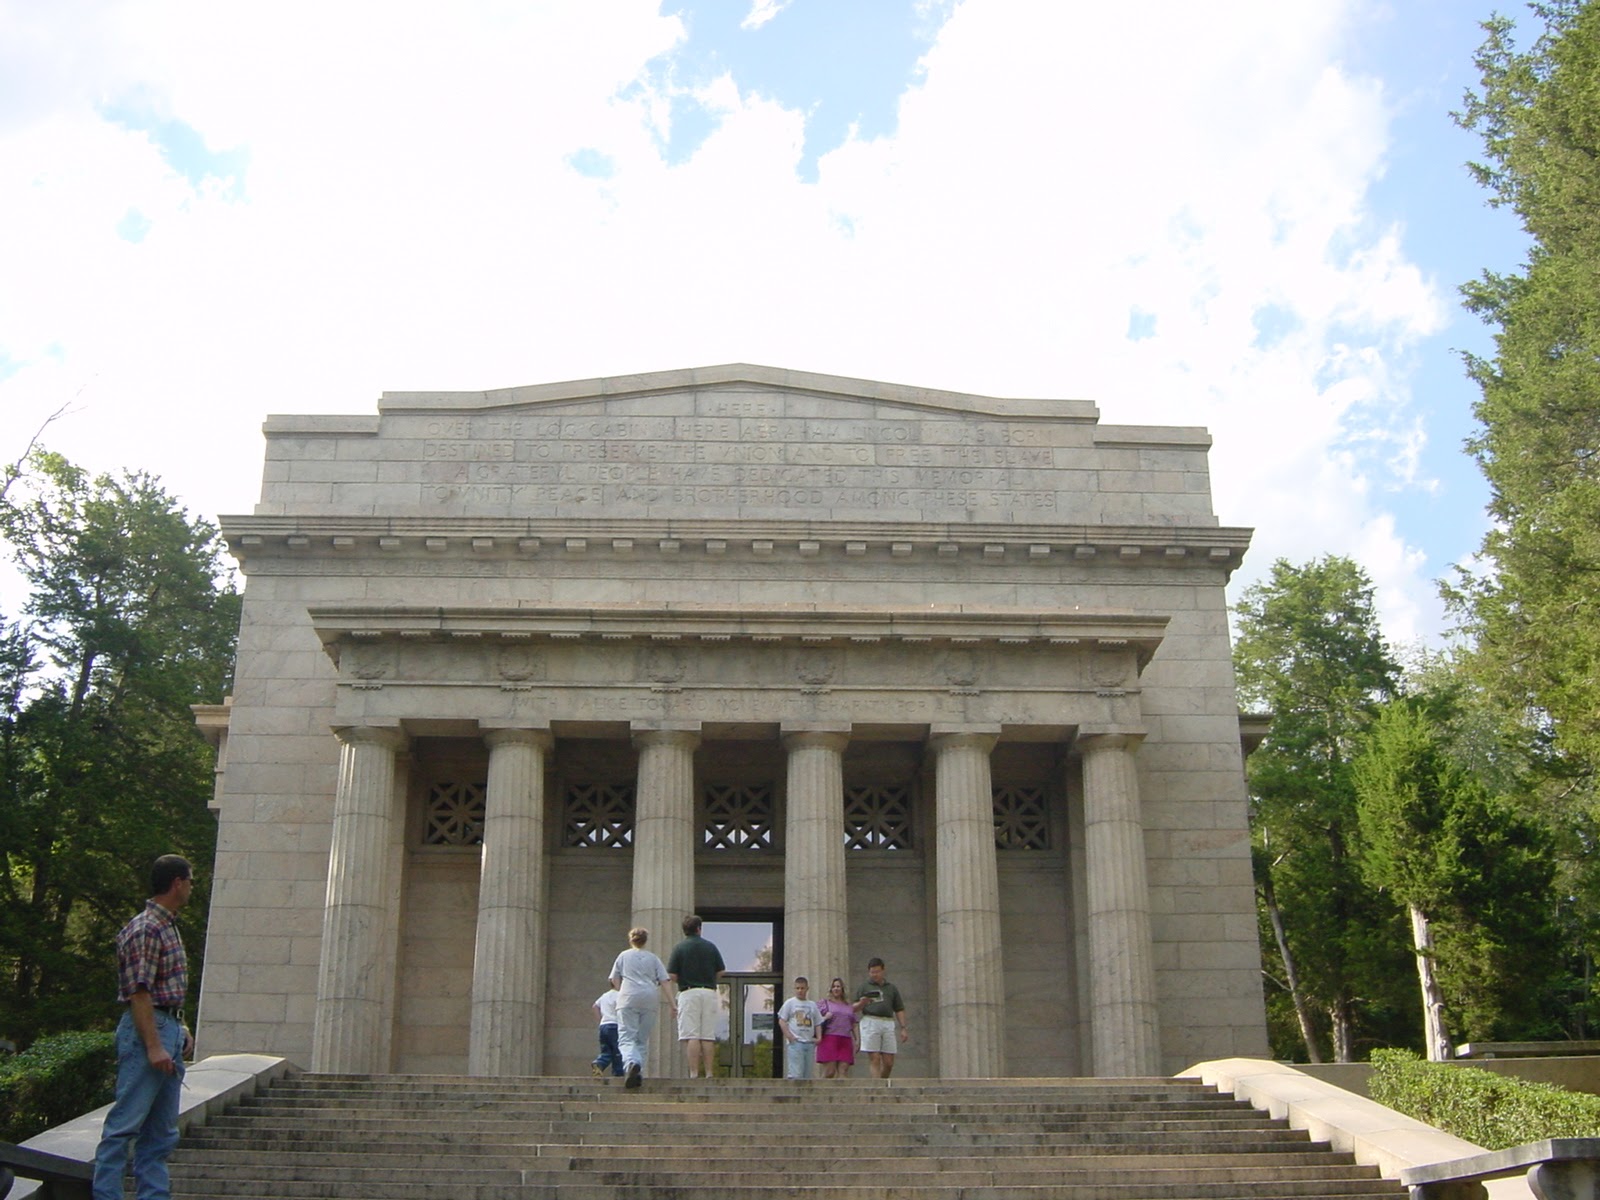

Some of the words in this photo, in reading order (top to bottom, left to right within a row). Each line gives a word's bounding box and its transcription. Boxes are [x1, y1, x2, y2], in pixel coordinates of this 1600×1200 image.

[716, 403, 767, 417] HERE
[428, 422, 474, 437] OVER
[488, 422, 523, 437] THE
[537, 422, 576, 437] LOG
[589, 423, 648, 438] CABIN
[741, 425, 839, 440] ABRAHAM
[1001, 429, 1052, 443] BORN
[424, 443, 514, 458] DESTINED
[525, 443, 550, 458] TO
[563, 444, 657, 459] PRESERVE
[669, 445, 705, 460] THE
[718, 446, 783, 461] VNION
[792, 447, 834, 462] AND
[844, 447, 869, 462] TO
[886, 448, 931, 463] FREE
[943, 449, 981, 464] THE
[994, 450, 1051, 465] SLAVE
[454, 465, 467, 479] A
[477, 465, 576, 480] GRATEFVL
[588, 466, 658, 481] PEOPLE
[670, 467, 720, 482] HAVE
[735, 467, 847, 483] DEDICATED
[858, 469, 899, 484] THIS
[915, 470, 1024, 486] MEMORIAL
[423, 485, 449, 500] TO
[537, 487, 602, 502] PEACE
[616, 488, 659, 503] AND
[672, 488, 824, 504] BROTHERHOOD
[836, 491, 910, 506] AMONG
[920, 491, 978, 507] THESE
[989, 492, 1054, 508] STATES
[514, 696, 558, 711] WITH
[636, 697, 708, 712] TOWARD
[897, 699, 928, 713] FOR
